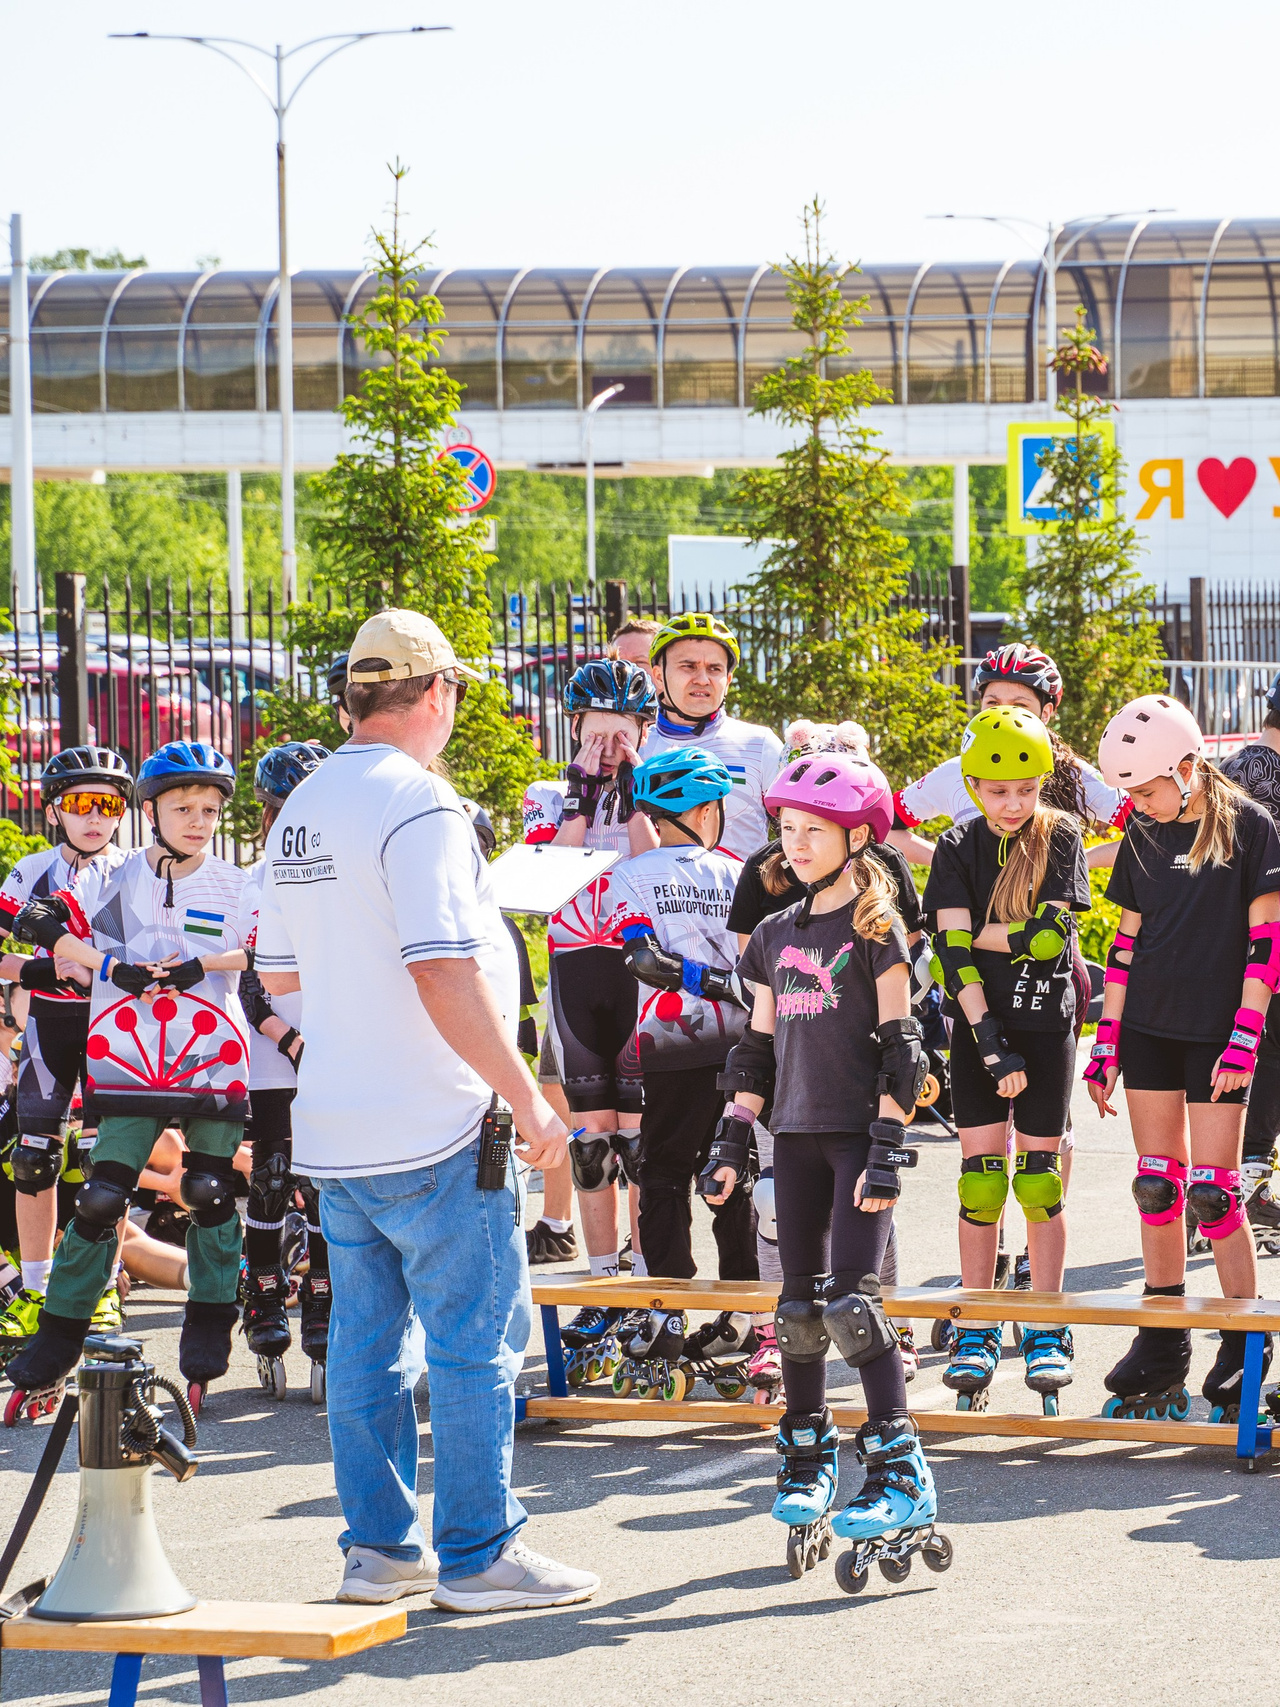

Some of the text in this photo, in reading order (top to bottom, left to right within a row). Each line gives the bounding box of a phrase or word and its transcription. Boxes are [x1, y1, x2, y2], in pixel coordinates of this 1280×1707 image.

[1135, 459, 1184, 519] Я
[813, 800, 836, 808] STERN
[653, 884, 732, 902] РЕСПУБЛИКА
[656, 899, 732, 918] БАШКОРТОСТАН
